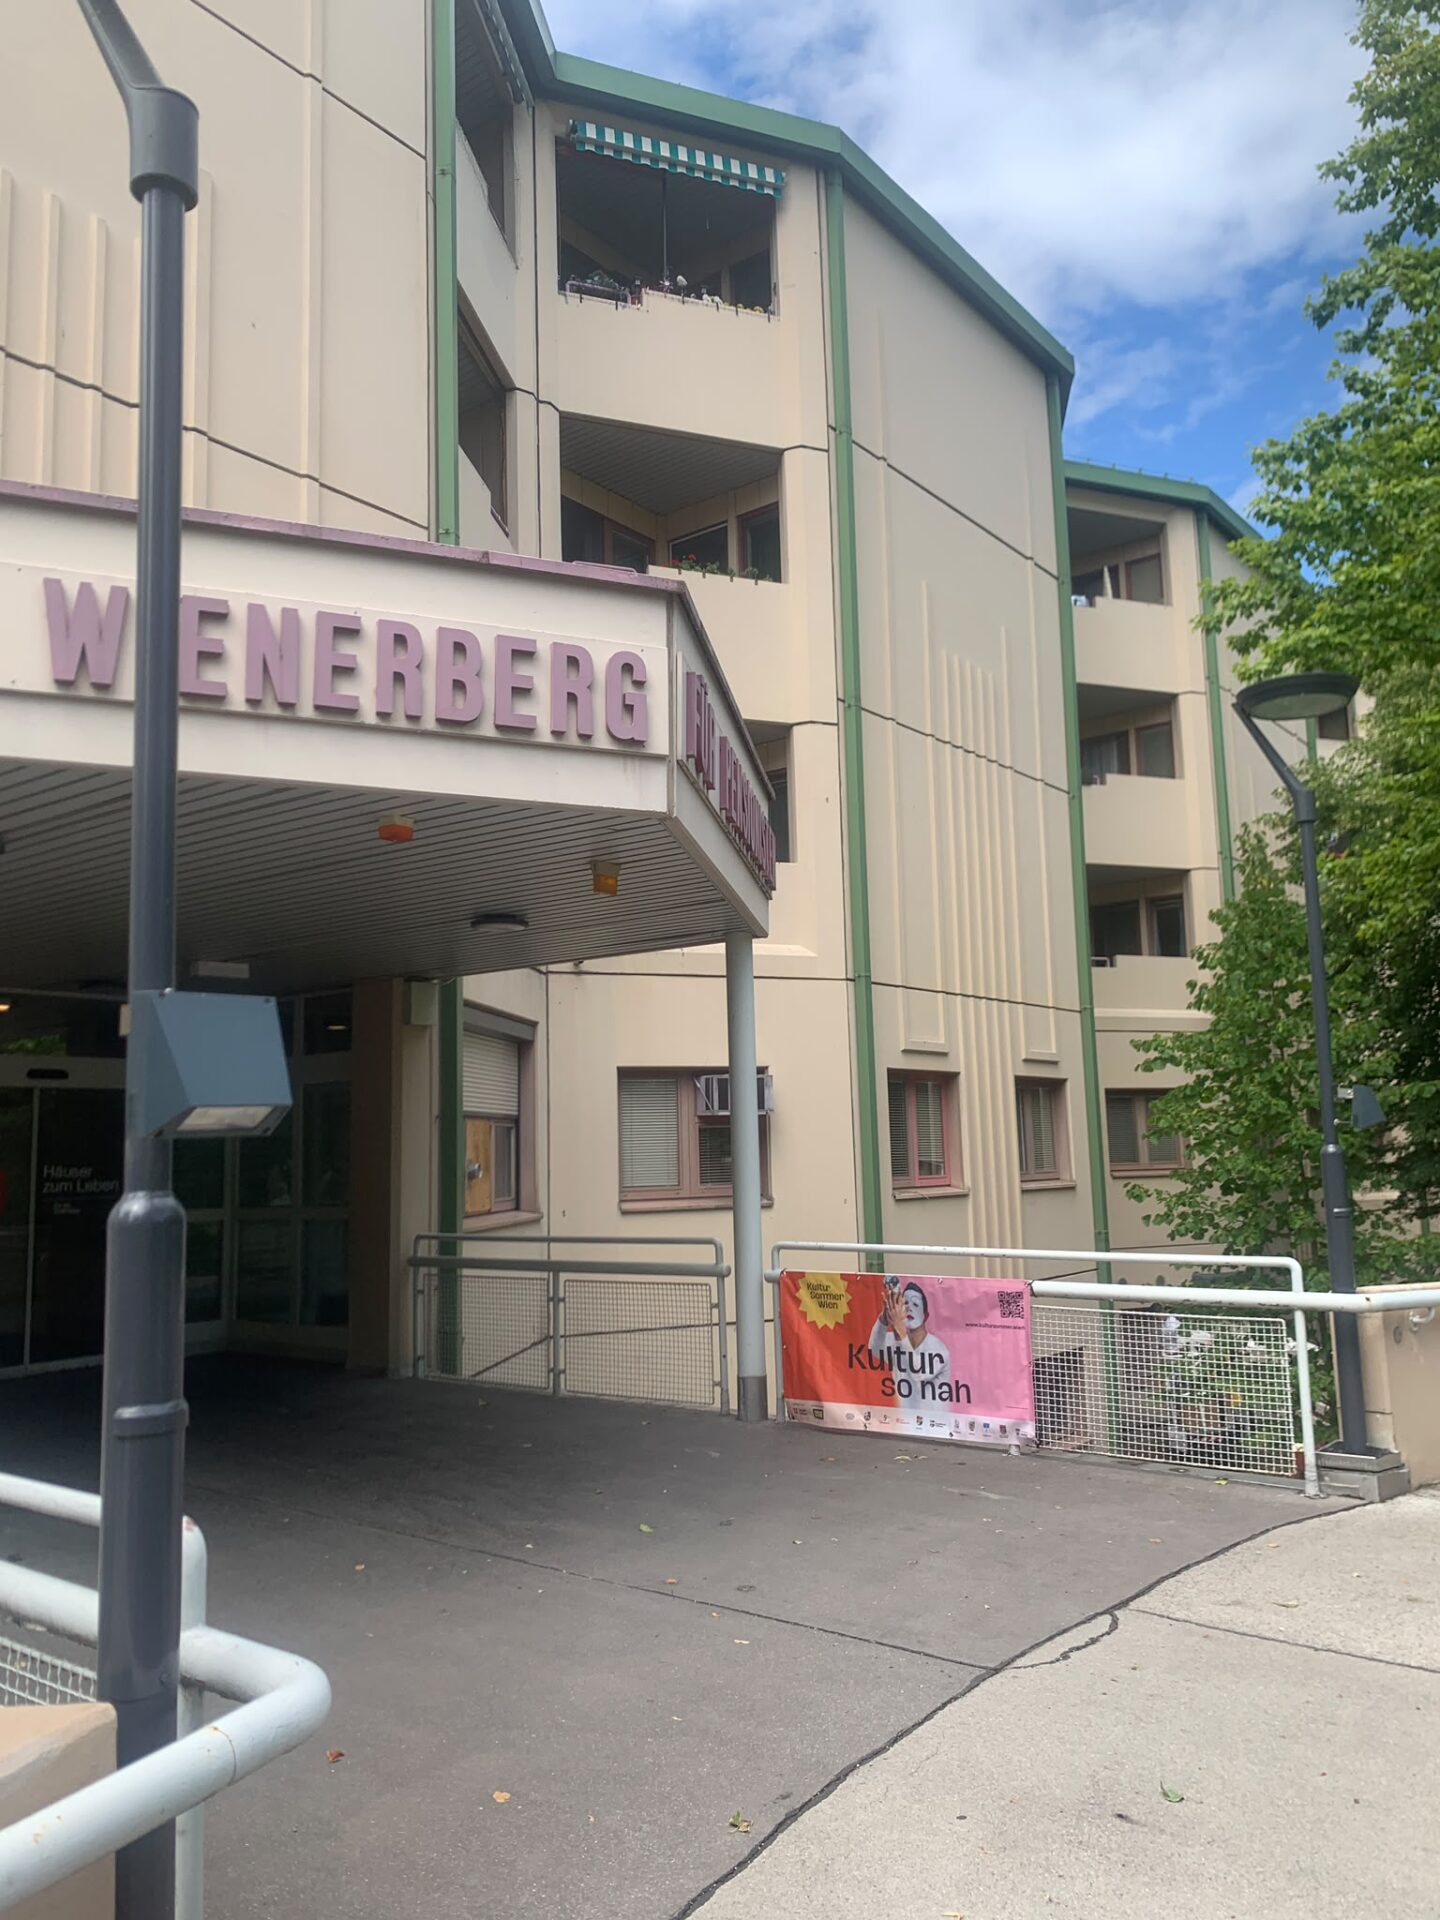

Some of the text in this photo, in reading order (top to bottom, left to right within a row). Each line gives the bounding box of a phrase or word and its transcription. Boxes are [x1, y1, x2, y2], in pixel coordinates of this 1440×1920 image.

[42, 576, 649, 747] WENERBERG
[687, 671, 716, 790] FÜR
[42, 1178, 119, 1193] zum Leben
[806, 1282, 831, 1292] Kultur
[810, 1291, 844, 1301] Sommer
[817, 1300, 838, 1309] Wien
[848, 1343, 945, 1375] Kultur
[881, 1377, 972, 1404] so nah
